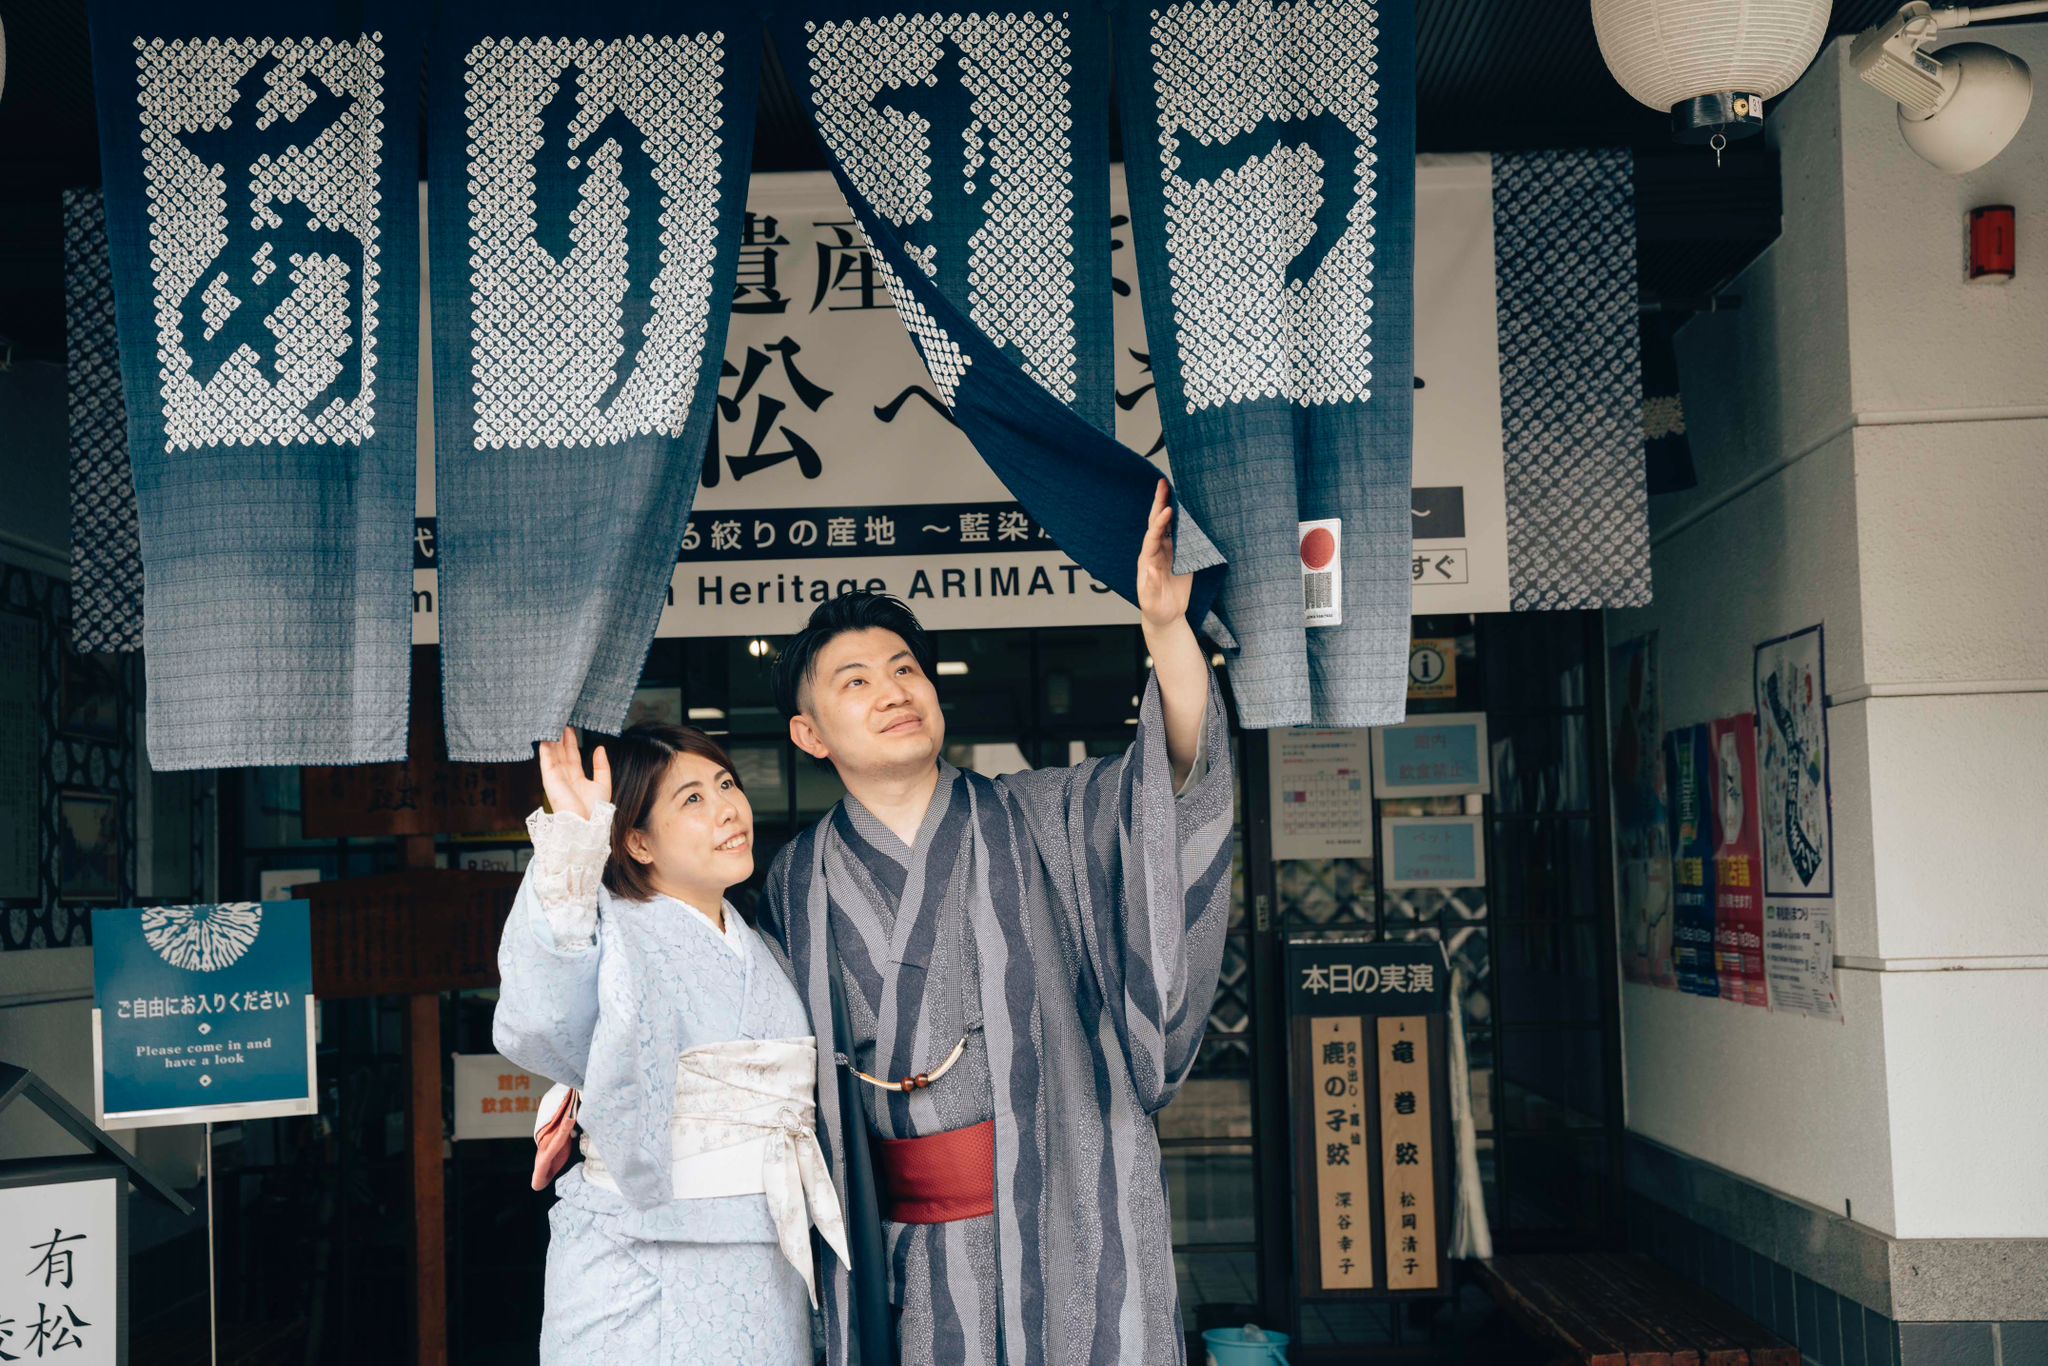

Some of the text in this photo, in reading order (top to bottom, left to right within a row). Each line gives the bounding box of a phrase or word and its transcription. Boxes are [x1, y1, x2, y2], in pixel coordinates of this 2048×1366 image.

[922, 511, 1051, 543] ～藍染
[1301, 964, 1434, 995] 本日の実演
[117, 990, 290, 1019] ご自由にお入りください
[136, 1038, 272, 1057] Please come in and
[165, 1053, 244, 1068] have a look
[1322, 1041, 1350, 1167] 鹿の子絞
[1400, 1191, 1419, 1275] 松岡清子
[25, 1228, 92, 1358] 有松
